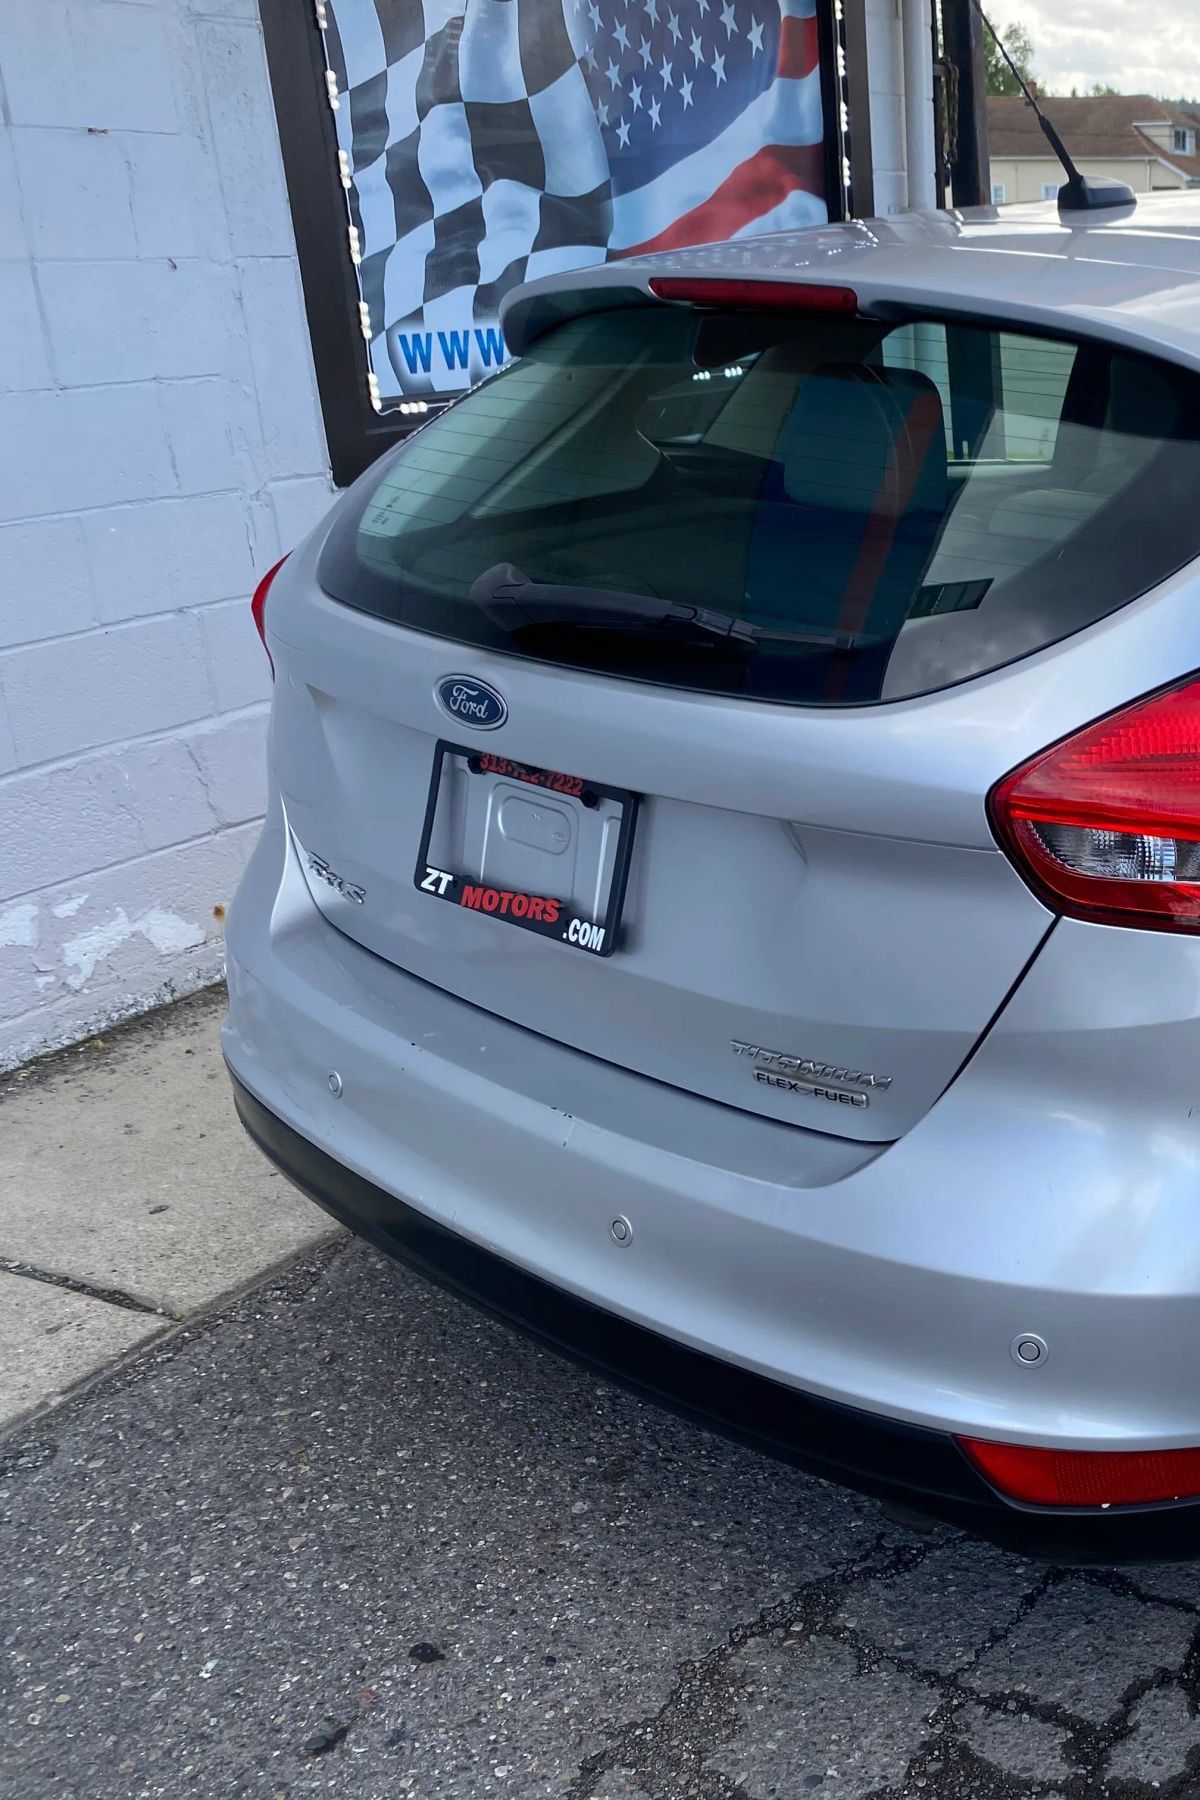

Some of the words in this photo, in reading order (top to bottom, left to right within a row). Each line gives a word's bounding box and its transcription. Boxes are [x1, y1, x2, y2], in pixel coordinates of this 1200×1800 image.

[449, 684, 490, 719] Ford
[420, 867, 454, 895] ZT
[460, 885, 561, 923] MOTORS
[562, 918, 606, 951] .COM
[730, 1039, 893, 1090] TITANIUM
[756, 1072, 800, 1092] FLEX
[814, 1087, 864, 1107] FUEL
